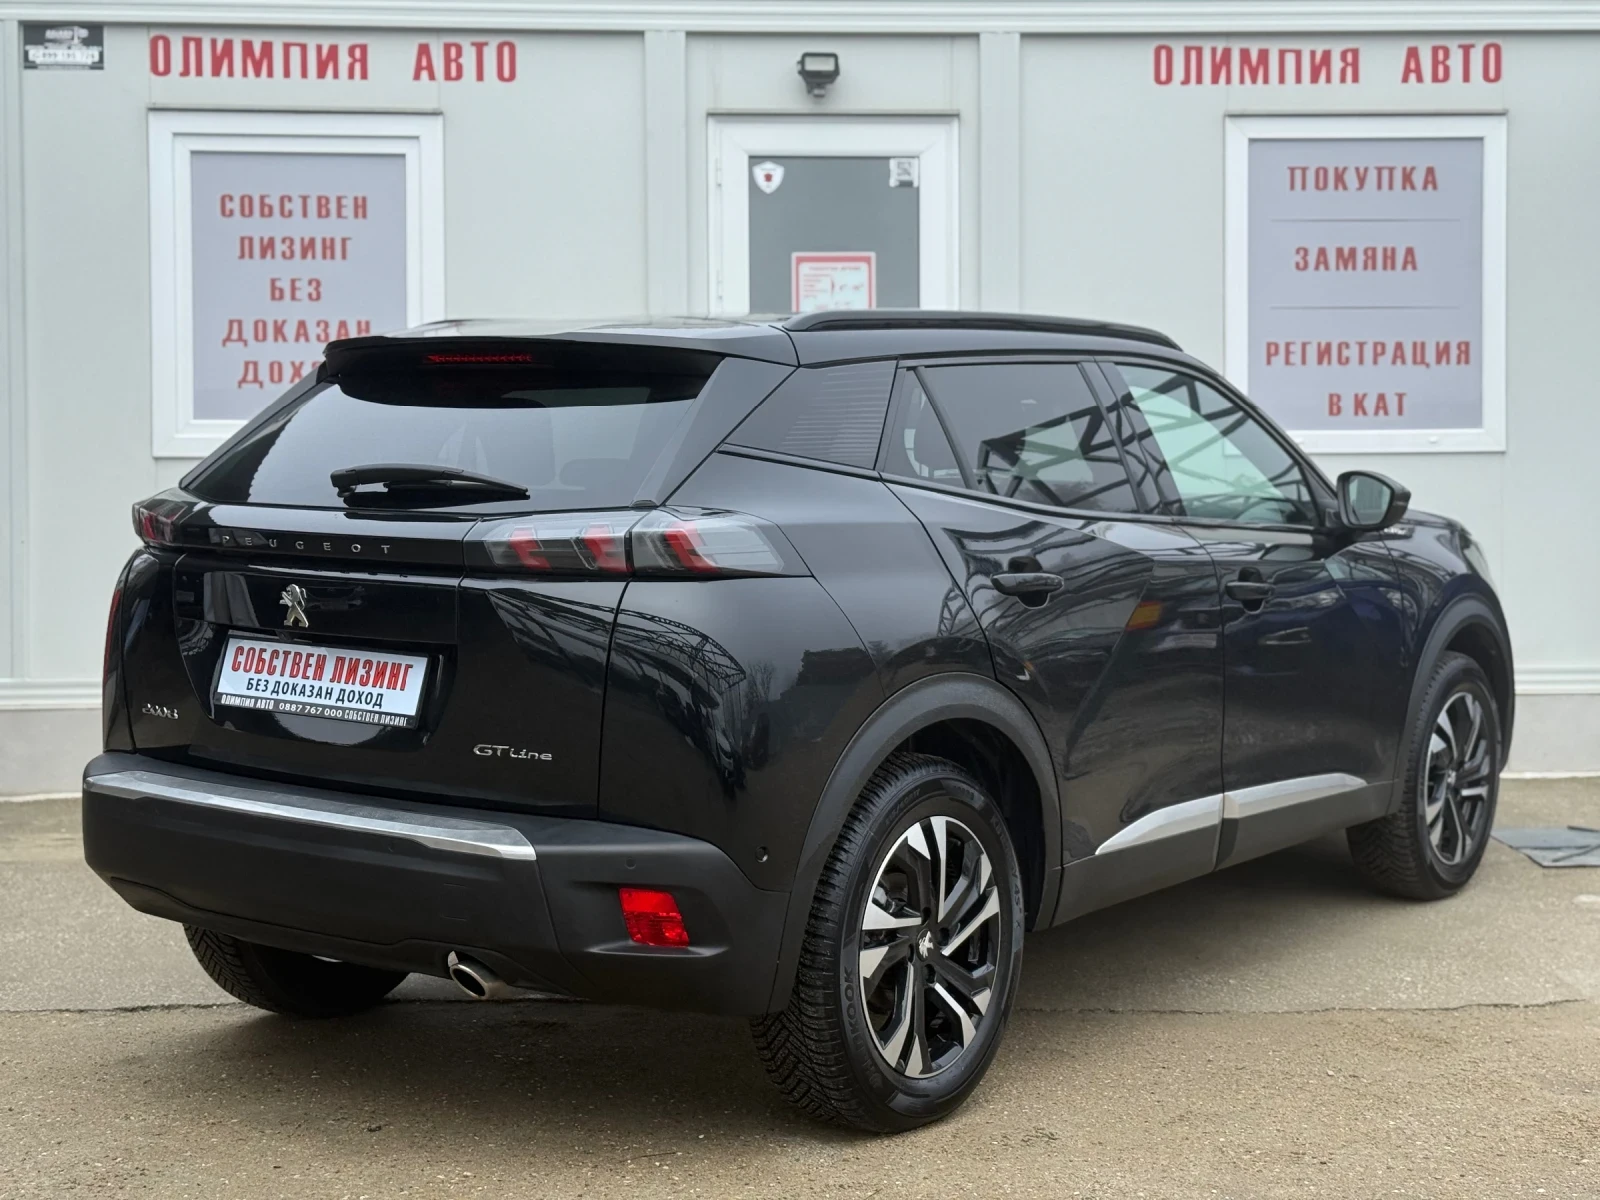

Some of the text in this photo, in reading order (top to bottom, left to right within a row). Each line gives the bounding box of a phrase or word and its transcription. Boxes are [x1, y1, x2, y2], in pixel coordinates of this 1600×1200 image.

[149, 34, 518, 82] ОЛИМПИЯ АВТО
[1153, 42, 1503, 85] ОЛИМПИЯ АВТО
[1287, 165, 1439, 192] ПОКУПКА
[219, 194, 368, 220] СОБСТВЕН
[237, 235, 353, 261] ЛИЗИНГ
[1294, 246, 1419, 272] ЗАМЯНА
[269, 277, 323, 302] БЕЗ
[222, 318, 371, 347] ДОКАЗАН
[1265, 341, 1471, 369] РЕГИСТРАЦИЯ
[1327, 392, 1408, 417] В КАТ
[221, 534, 391, 555] PEUGEOT
[231, 645, 414, 692] СОБСТВЕН ЛИЗИНГ
[246, 677, 385, 710] БЕЗ ДОКАЗАН ДОХОД
[220, 693, 409, 727] ОЛИМПИЯ АВТО 0887 767 000 СОБСТВЕН ЛИЗИНГ
[473, 743, 510, 757] GT
